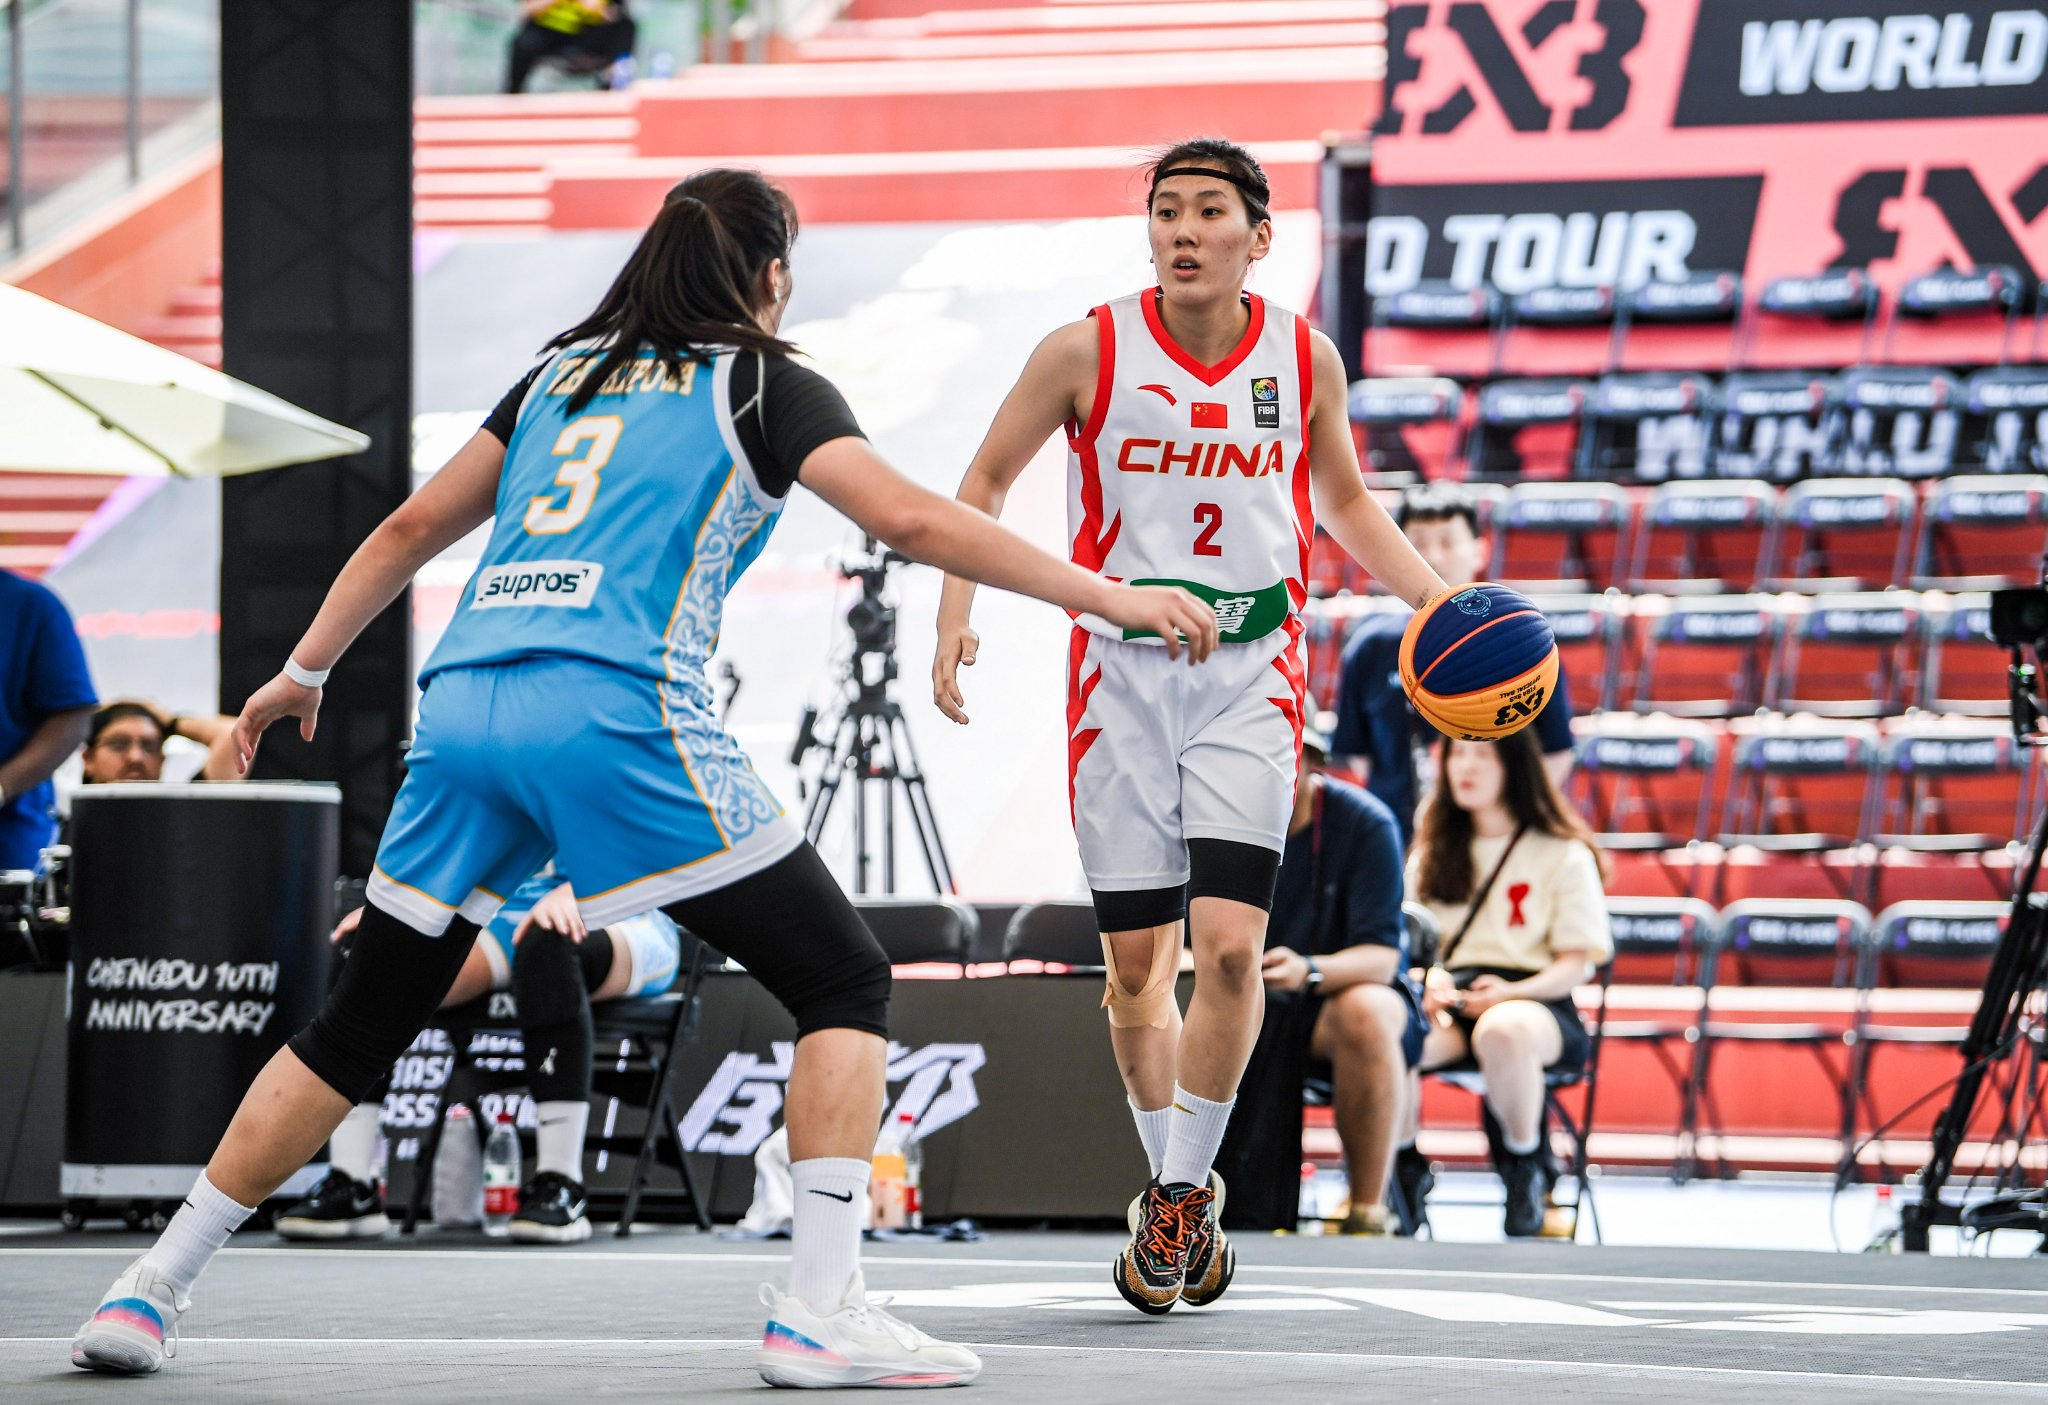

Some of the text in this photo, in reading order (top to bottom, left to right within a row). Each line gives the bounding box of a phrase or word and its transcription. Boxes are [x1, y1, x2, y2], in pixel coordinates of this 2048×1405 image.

[1739, 9, 2048, 96] WORLD
[1443, 208, 1697, 295] TOUR
[1258, 405, 1276, 415] FIBA
[523, 415, 624, 535] 3
[1117, 438, 1283, 478] CHINA
[1193, 502, 1222, 556] 2
[485, 572, 580, 599] supros
[1499, 675, 1541, 699] OFFICIAL BALL
[1522, 685, 1536, 697] FIBA
[87, 957, 208, 991] CHENGDU
[86, 998, 275, 1036] ANNIVERSARY
